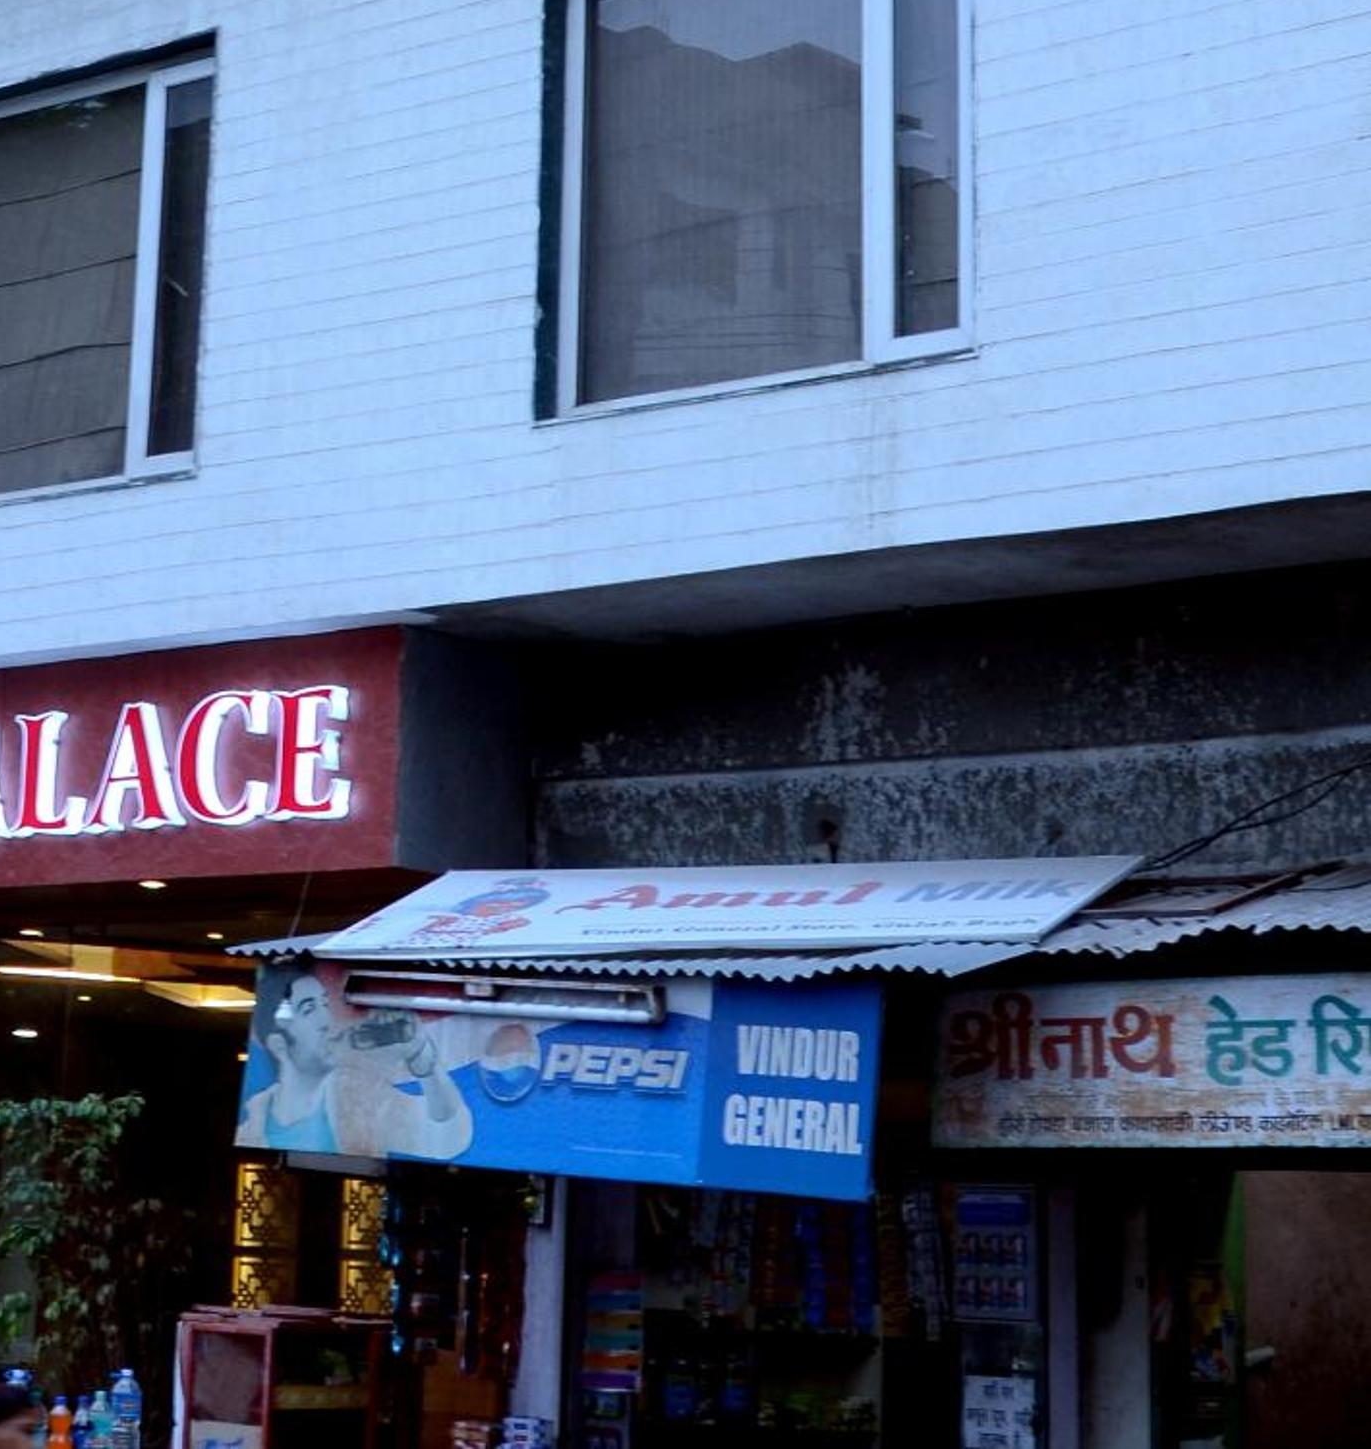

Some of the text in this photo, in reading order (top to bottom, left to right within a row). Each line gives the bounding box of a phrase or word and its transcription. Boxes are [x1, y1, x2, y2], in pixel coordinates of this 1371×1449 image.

[553, 878, 1089, 914] Amul Milk
[541, 1043, 690, 1090] PEPSI
[737, 1024, 860, 1082] VINDUR
[949, 991, 1371, 1086] श्रीनाथ हेड रि
[723, 1093, 863, 1156] GENERAL
